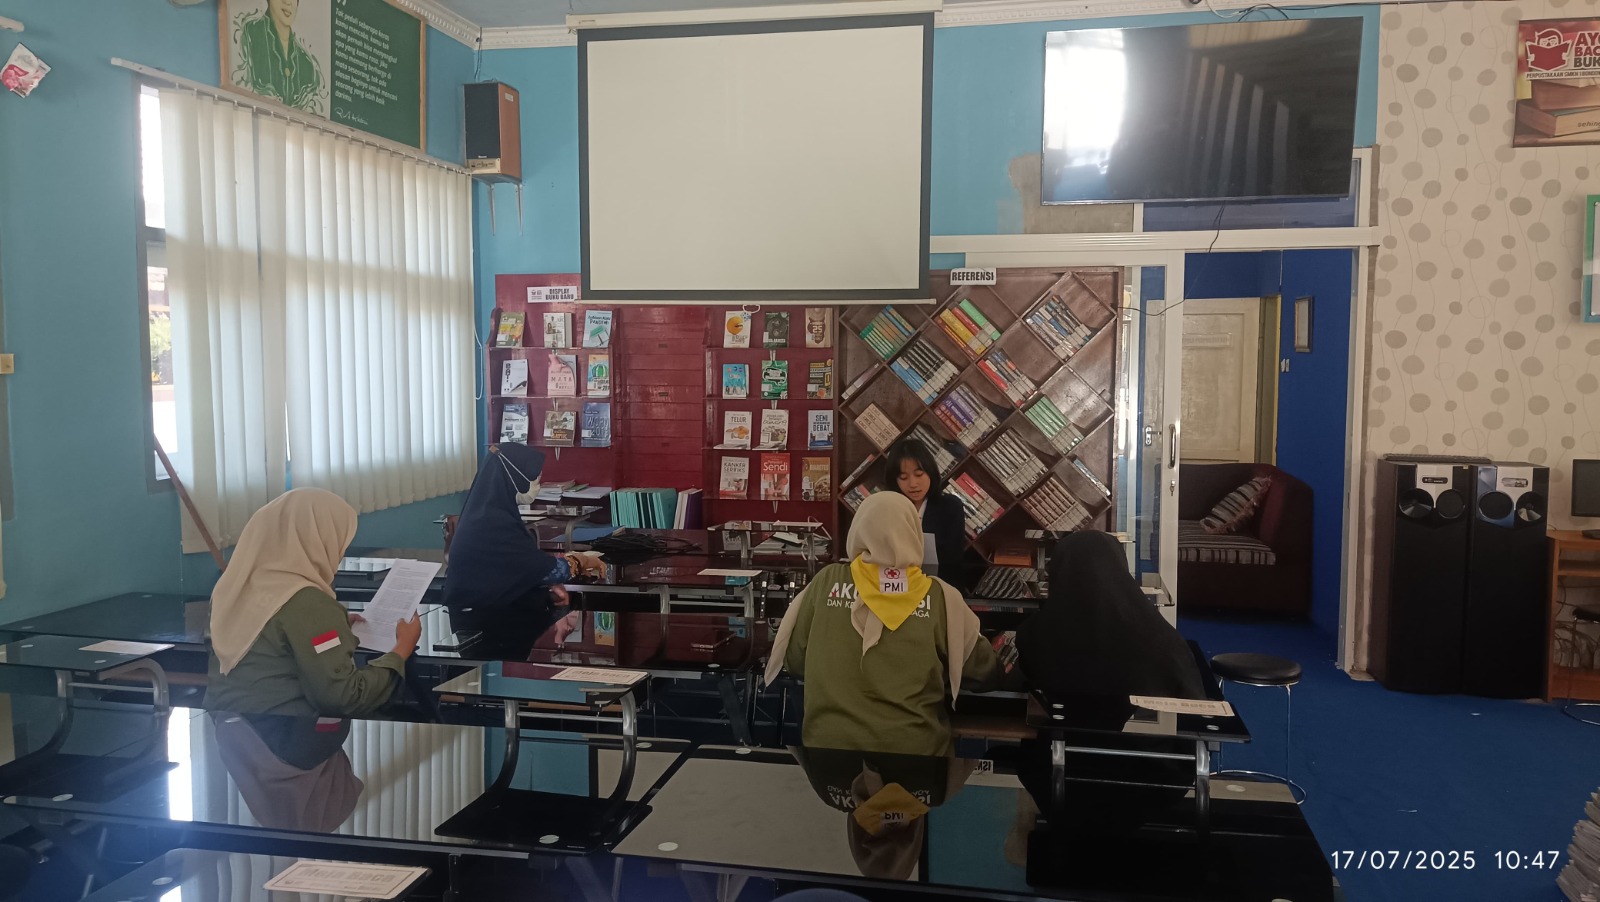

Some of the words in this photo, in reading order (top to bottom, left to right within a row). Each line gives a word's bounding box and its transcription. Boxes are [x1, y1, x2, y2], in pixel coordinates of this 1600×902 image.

[1575, 32, 1600, 46] AY
[952, 271, 994, 281] REFERENSI
[812, 325, 822, 333] 25
[815, 414, 828, 422] SENI
[813, 424, 830, 432] DEBAT
[763, 461, 788, 471] Sendi
[884, 582, 904, 592] PMI
[827, 599, 843, 607] DAN
